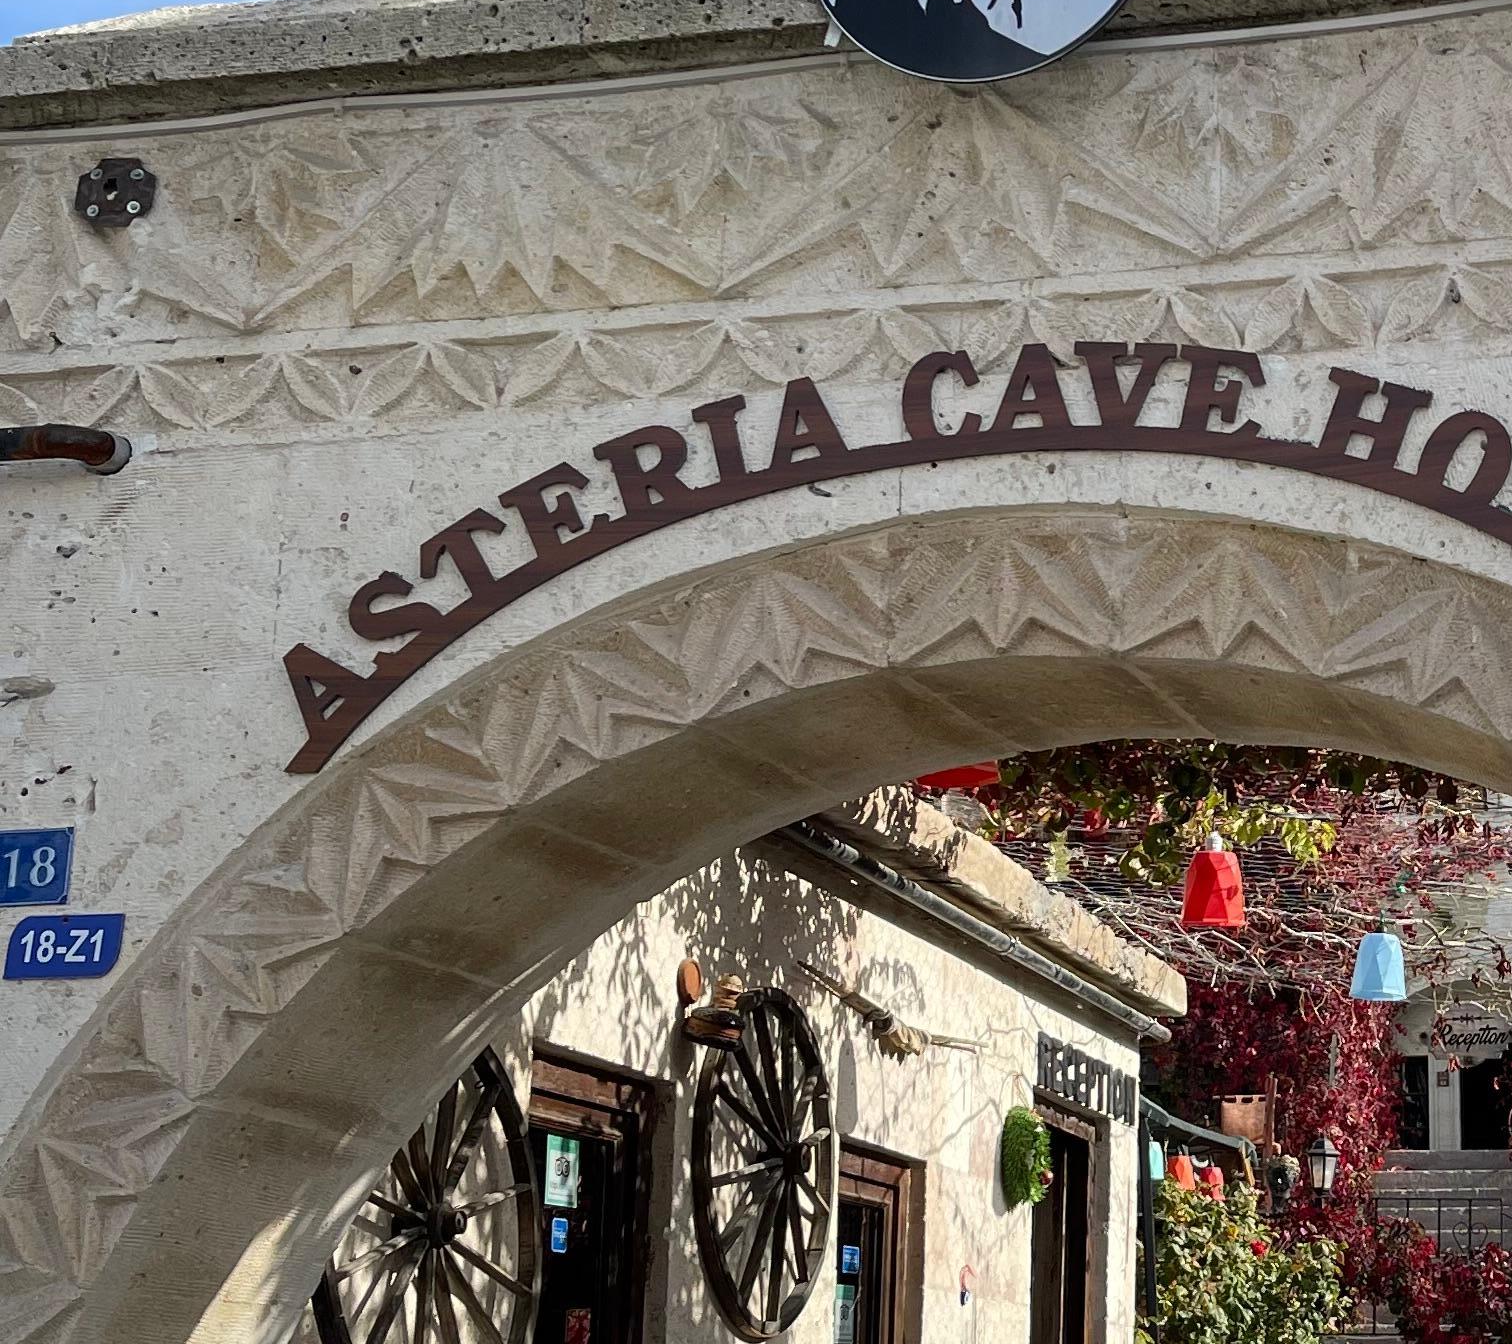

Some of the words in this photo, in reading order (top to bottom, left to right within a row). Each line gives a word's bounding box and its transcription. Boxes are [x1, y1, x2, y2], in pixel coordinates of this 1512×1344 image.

[282, 375, 850, 774] ASTERIA
[902, 341, 1266, 446] CAVE
[4, 846, 56, 889] 18
[20, 929, 104, 964] 18-Z1
